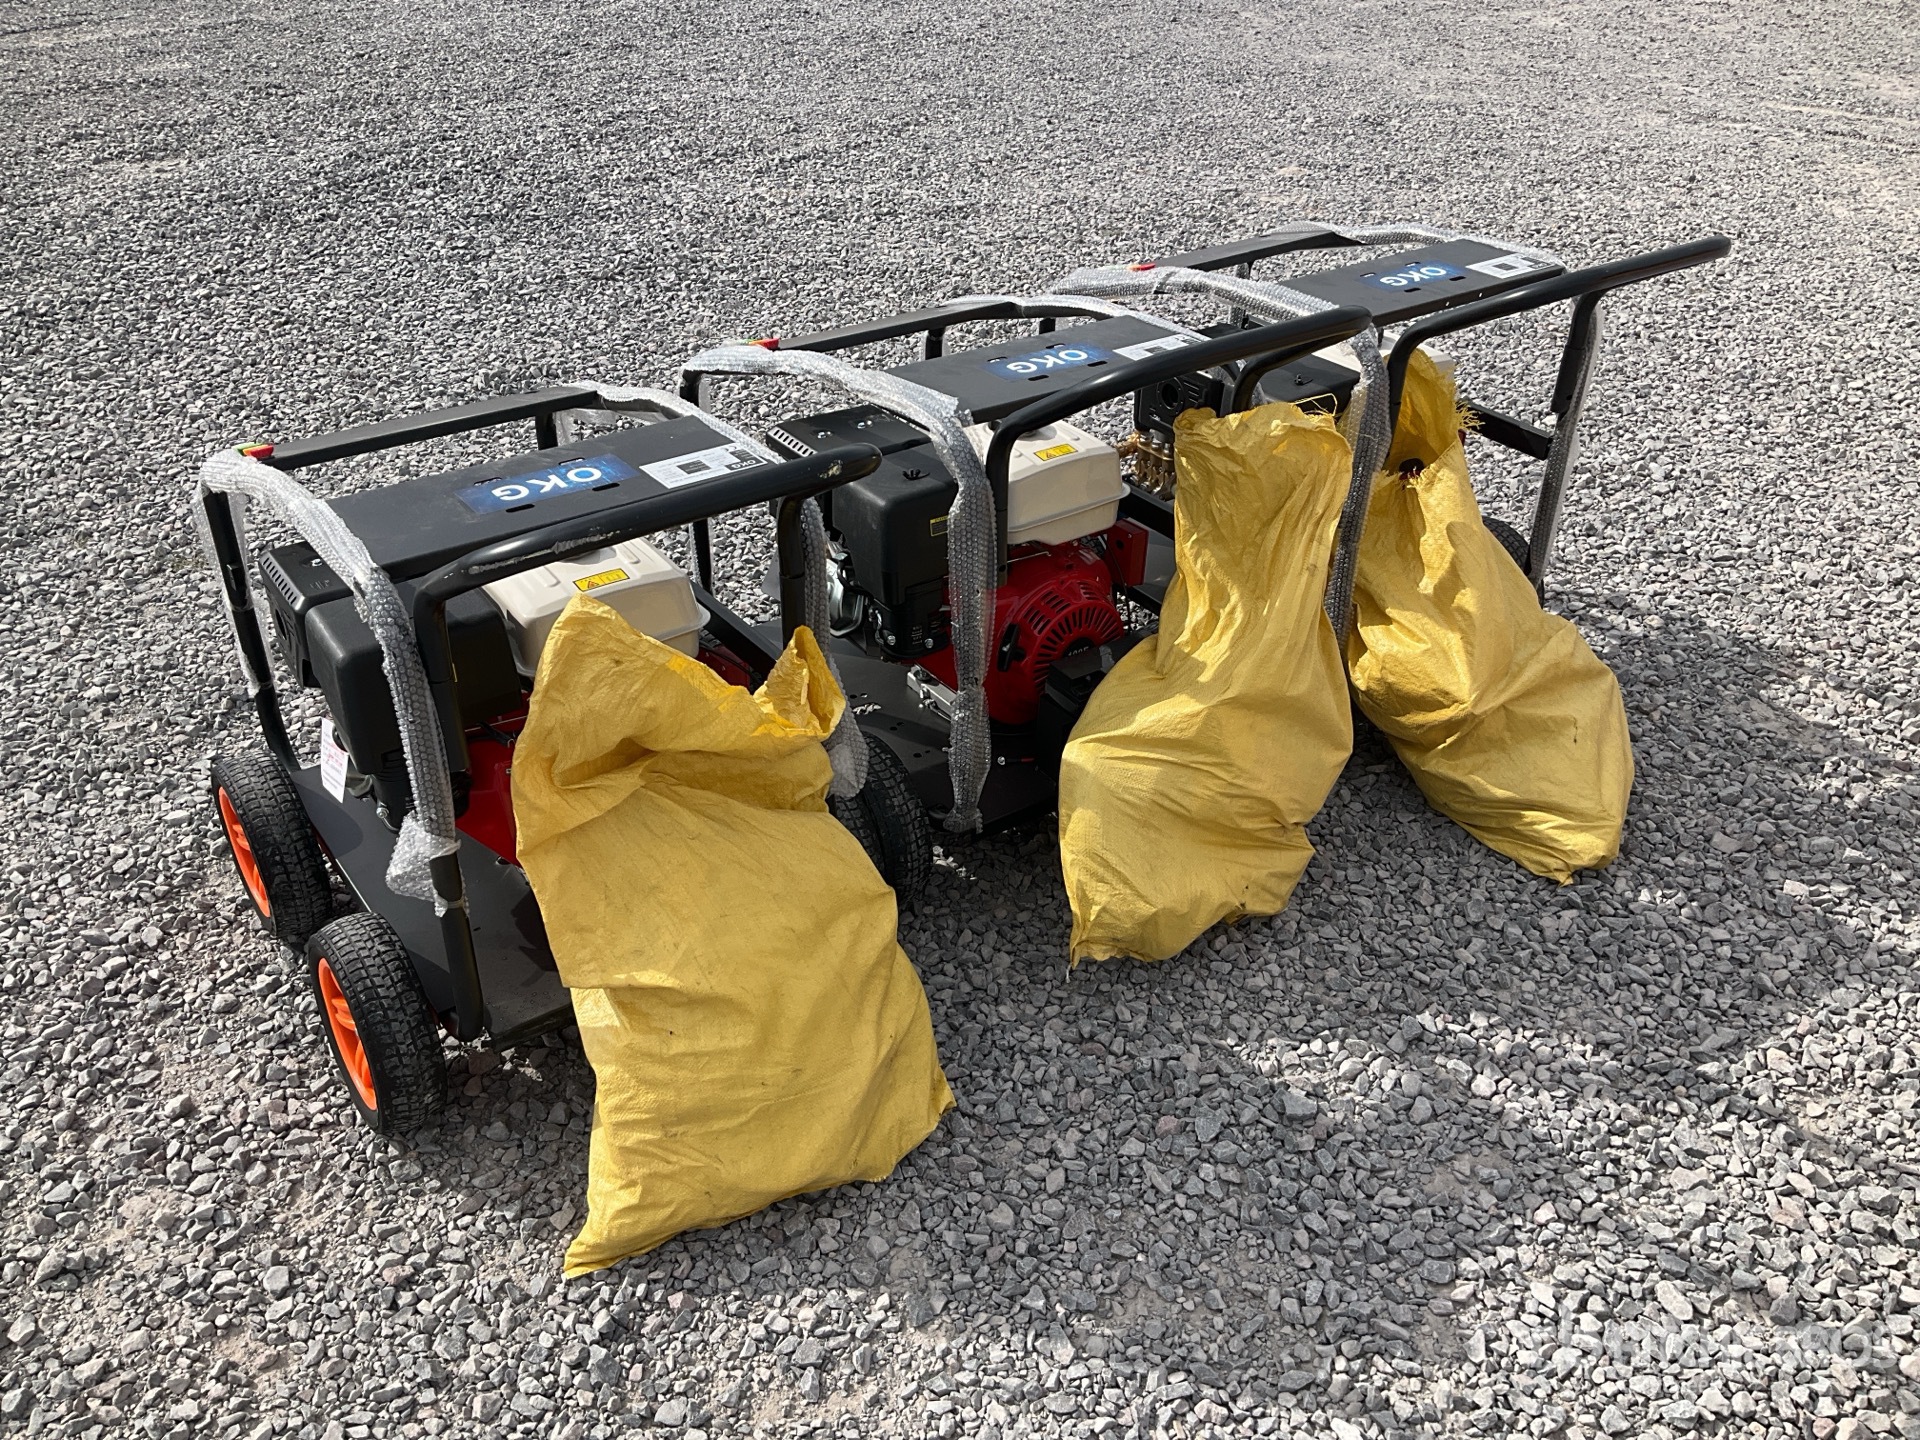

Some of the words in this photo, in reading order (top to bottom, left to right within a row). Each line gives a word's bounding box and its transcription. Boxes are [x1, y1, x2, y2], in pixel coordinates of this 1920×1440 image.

[1379, 266, 1447, 287] OKG
[1006, 349, 1089, 373] OKG
[491, 467, 602, 501] OKG
